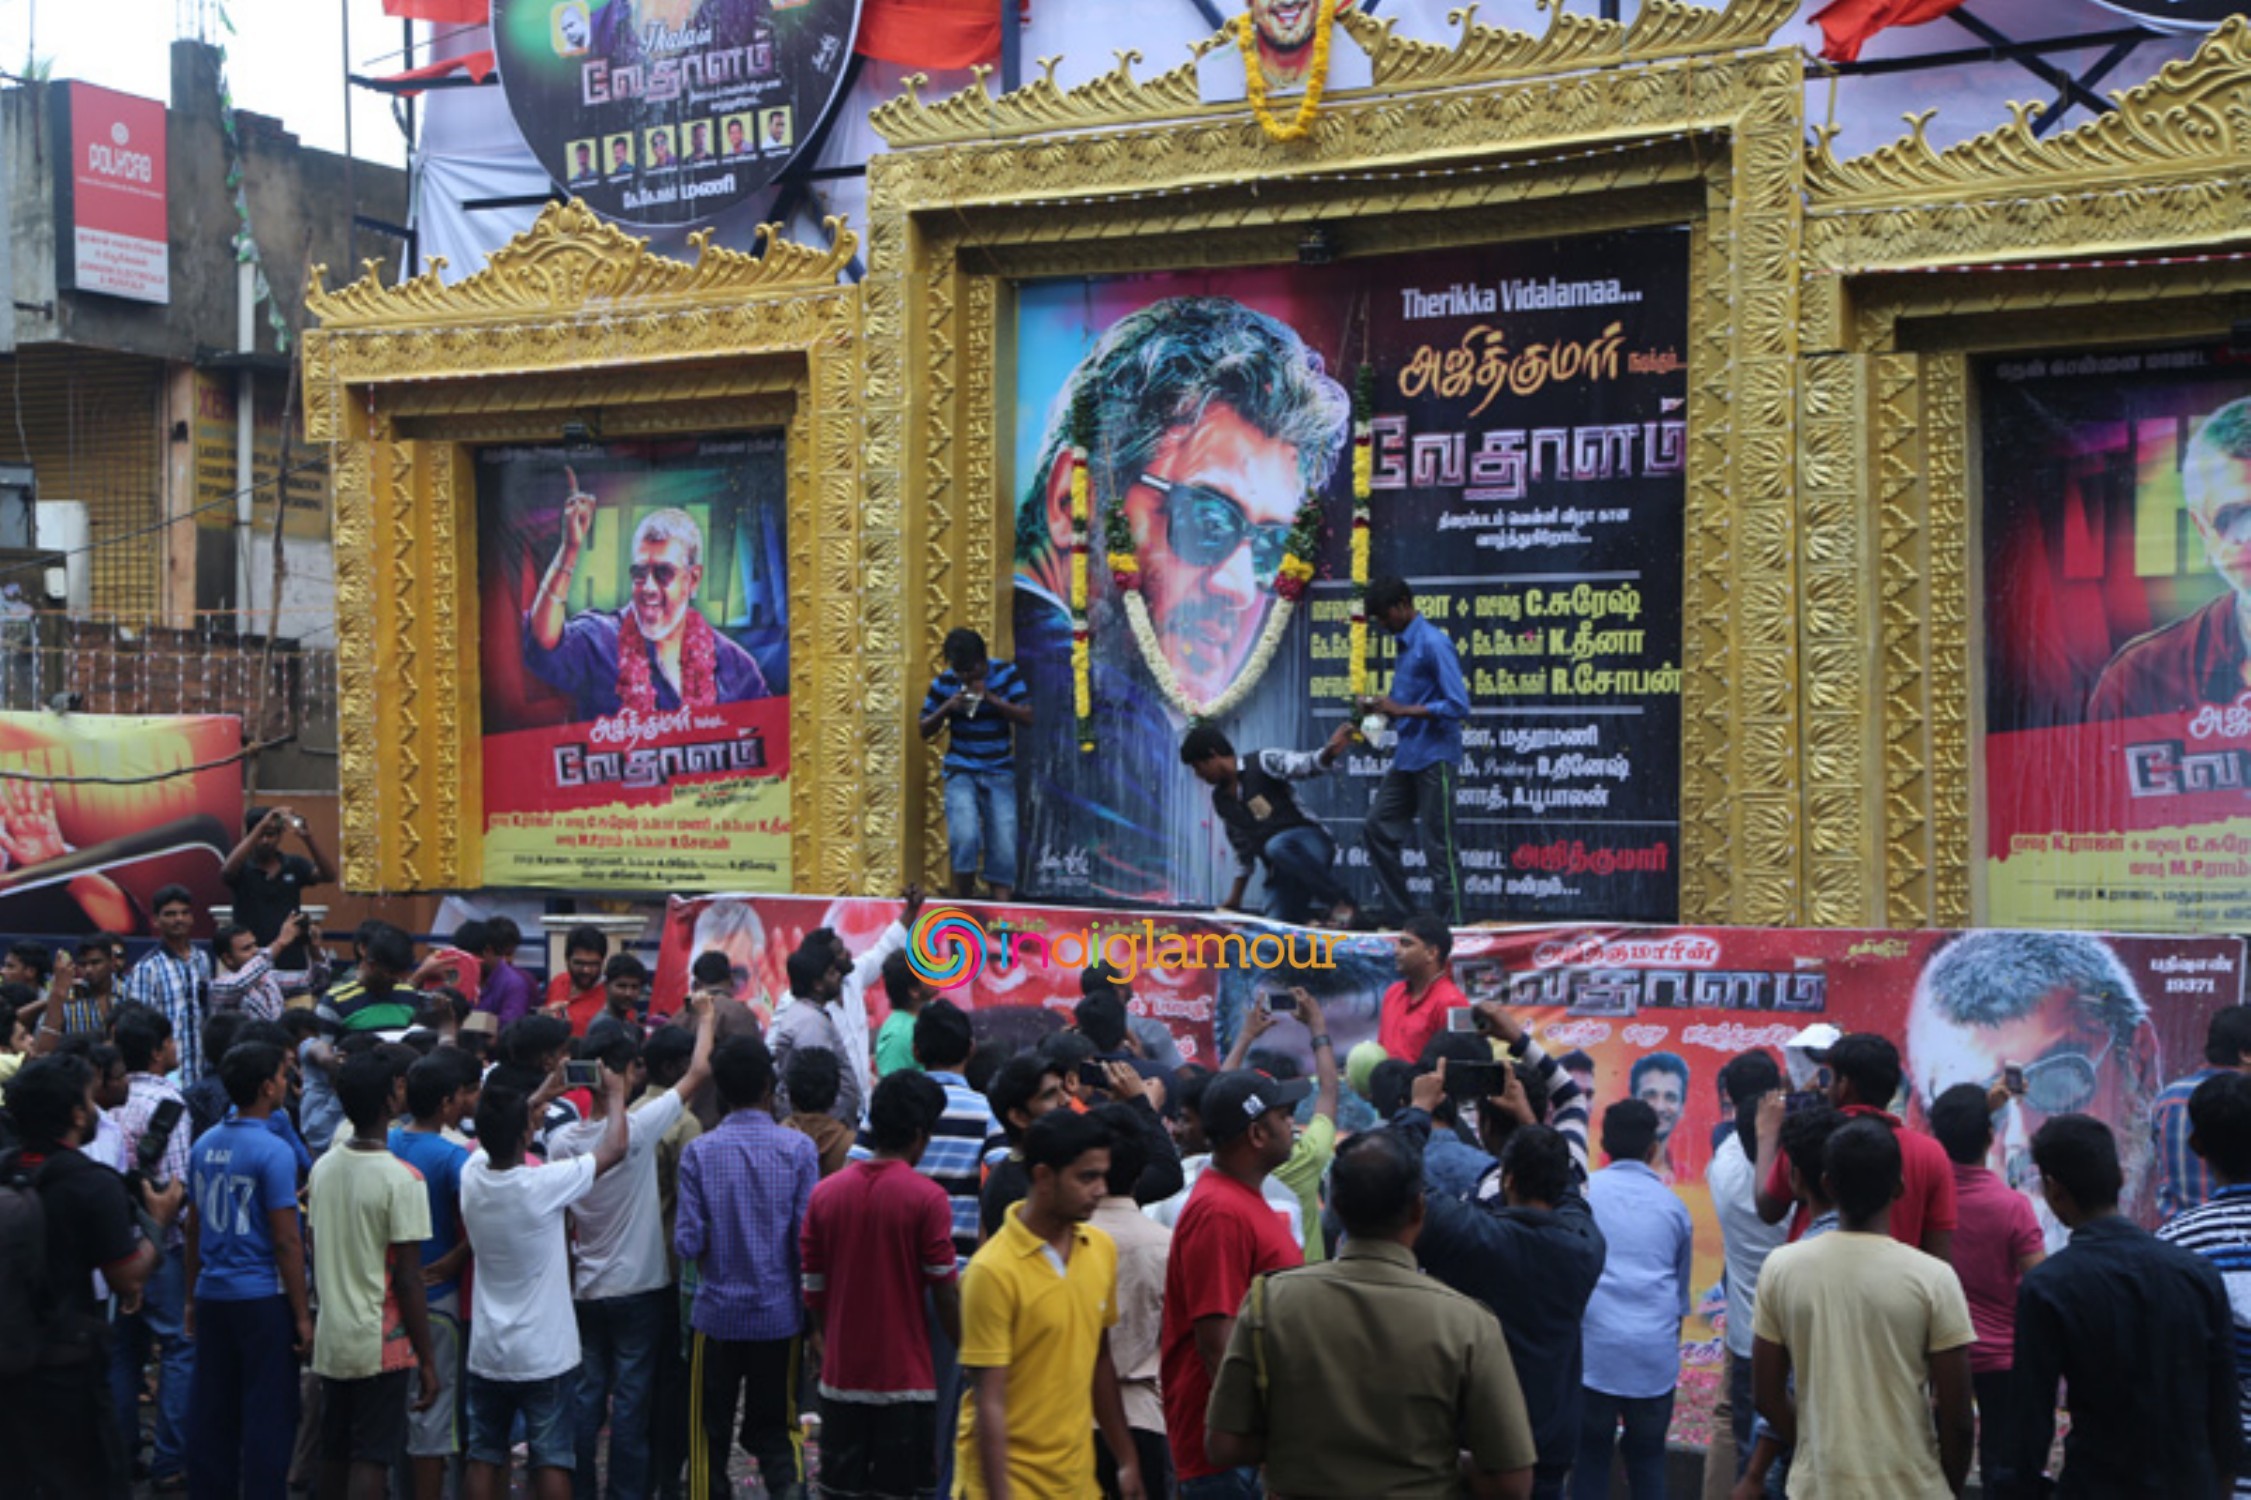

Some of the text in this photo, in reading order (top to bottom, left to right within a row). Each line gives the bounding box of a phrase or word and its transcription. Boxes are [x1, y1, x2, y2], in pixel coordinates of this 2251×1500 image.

[88, 143, 152, 183] POLYCAB
[1401, 277, 1642, 320] Therikka Vidalamaa...
[1399, 320, 1626, 418] அஜித்குமார்
[1370, 397, 1686, 499] வேதாளம்
[1525, 583, 1641, 624] C.சுரேஷ்
[1549, 619, 1645, 660] K.தீனா
[1511, 840, 1669, 875] அஜித்குமார்
